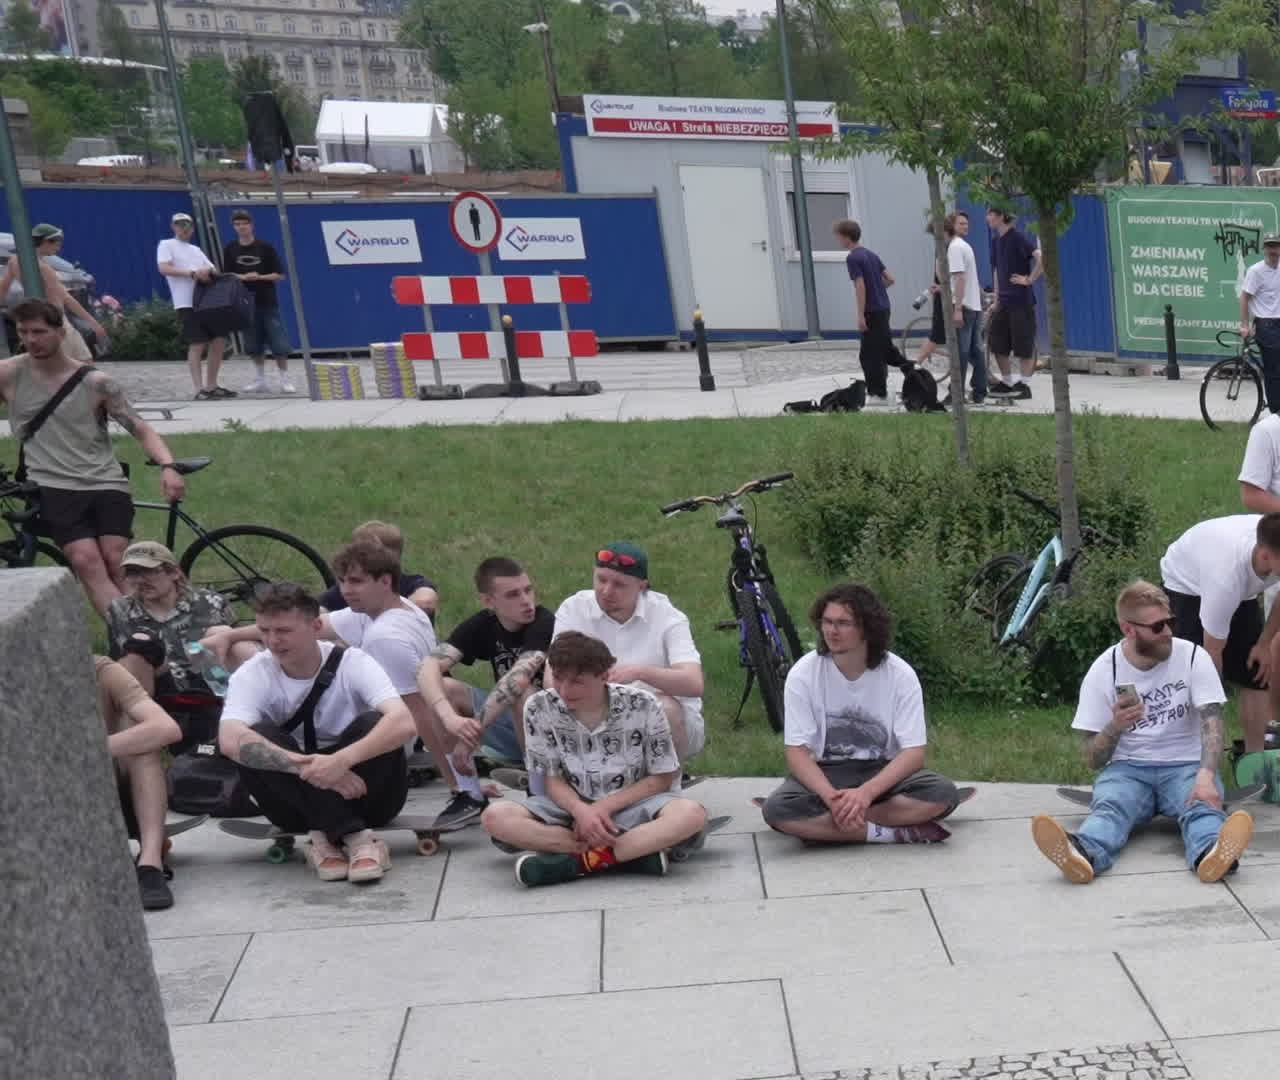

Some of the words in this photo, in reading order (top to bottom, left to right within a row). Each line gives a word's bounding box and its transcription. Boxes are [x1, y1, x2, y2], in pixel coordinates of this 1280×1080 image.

[629, 120, 671, 132] UWAGA
[682, 121, 713, 133] Strefa
[347, 237, 409, 246] WARBUD
[516, 233, 575, 243] WARBUD
[1130, 246, 1207, 261] ZMIENIAMY
[1132, 264, 1209, 282] WARSZAWĘ
[1134, 283, 1161, 296] DLA
[1161, 284, 1206, 298] CIEBIE
[1140, 680, 1188, 704] KATE
